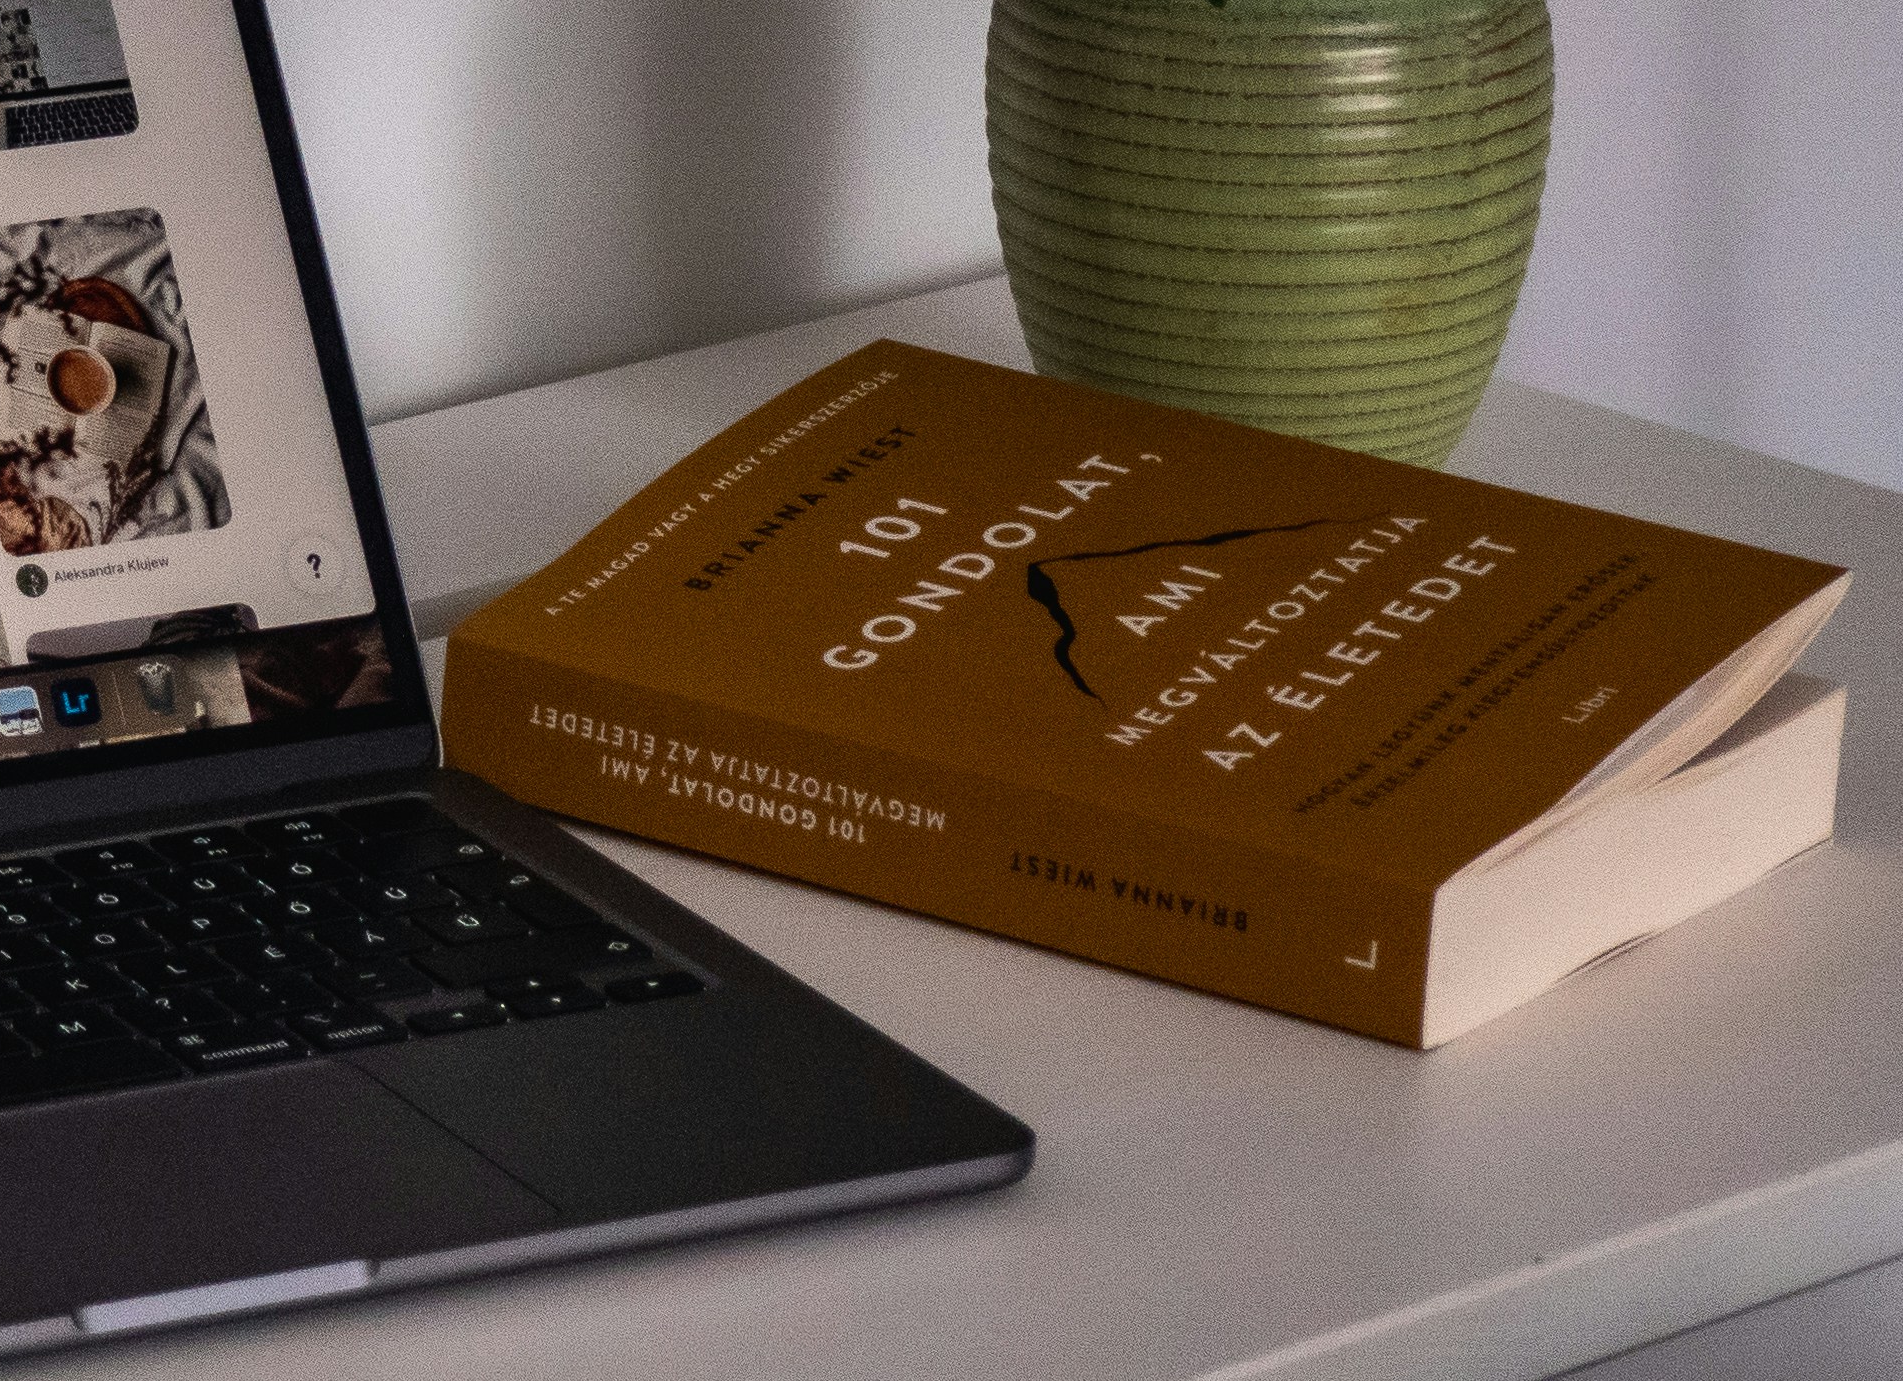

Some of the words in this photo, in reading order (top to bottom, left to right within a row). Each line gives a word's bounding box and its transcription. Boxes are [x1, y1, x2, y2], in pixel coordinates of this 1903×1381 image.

[544, 604, 563, 618] A
[559, 587, 588, 606] TE
[585, 539, 652, 592] MAGAD
[647, 502, 699, 541] VAGY
[697, 489, 715, 505] A
[711, 454, 763, 492] HEGY
[759, 369, 899, 458] SIKERSZERZŐJE
[682, 491, 828, 592] BRIANNA
[822, 424, 918, 485] WIEST
[839, 496, 949, 560] 101
[54, 562, 124, 583] Aleksandra
[127, 556, 169, 575] Klujew
[307, 553, 321, 579] ?
[1114, 564, 1223, 639] AMI
[1104, 515, 1430, 748] MEGVÁLTOZTATJA
[1201, 722, 1283, 772] AZ
[1265, 534, 1518, 712] ÉLETEDET
[61, 690, 91, 717] Lr
[1562, 684, 1620, 725] Libri
[528, 703, 656, 760] ÉLETEDET
[665, 739, 699, 766] AZ
[600, 754, 650, 785] AMI
[709, 750, 947, 832] MEGVÁLTOZTATJA
[659, 764, 818, 831] GONDOLAT,
[828, 816, 866, 845] 101
[1010, 850, 1096, 892] WIEST
[1111, 876, 1249, 933] BRIANNA
[201, 1038, 289, 1062] command
[326, 1024, 385, 1040] option
